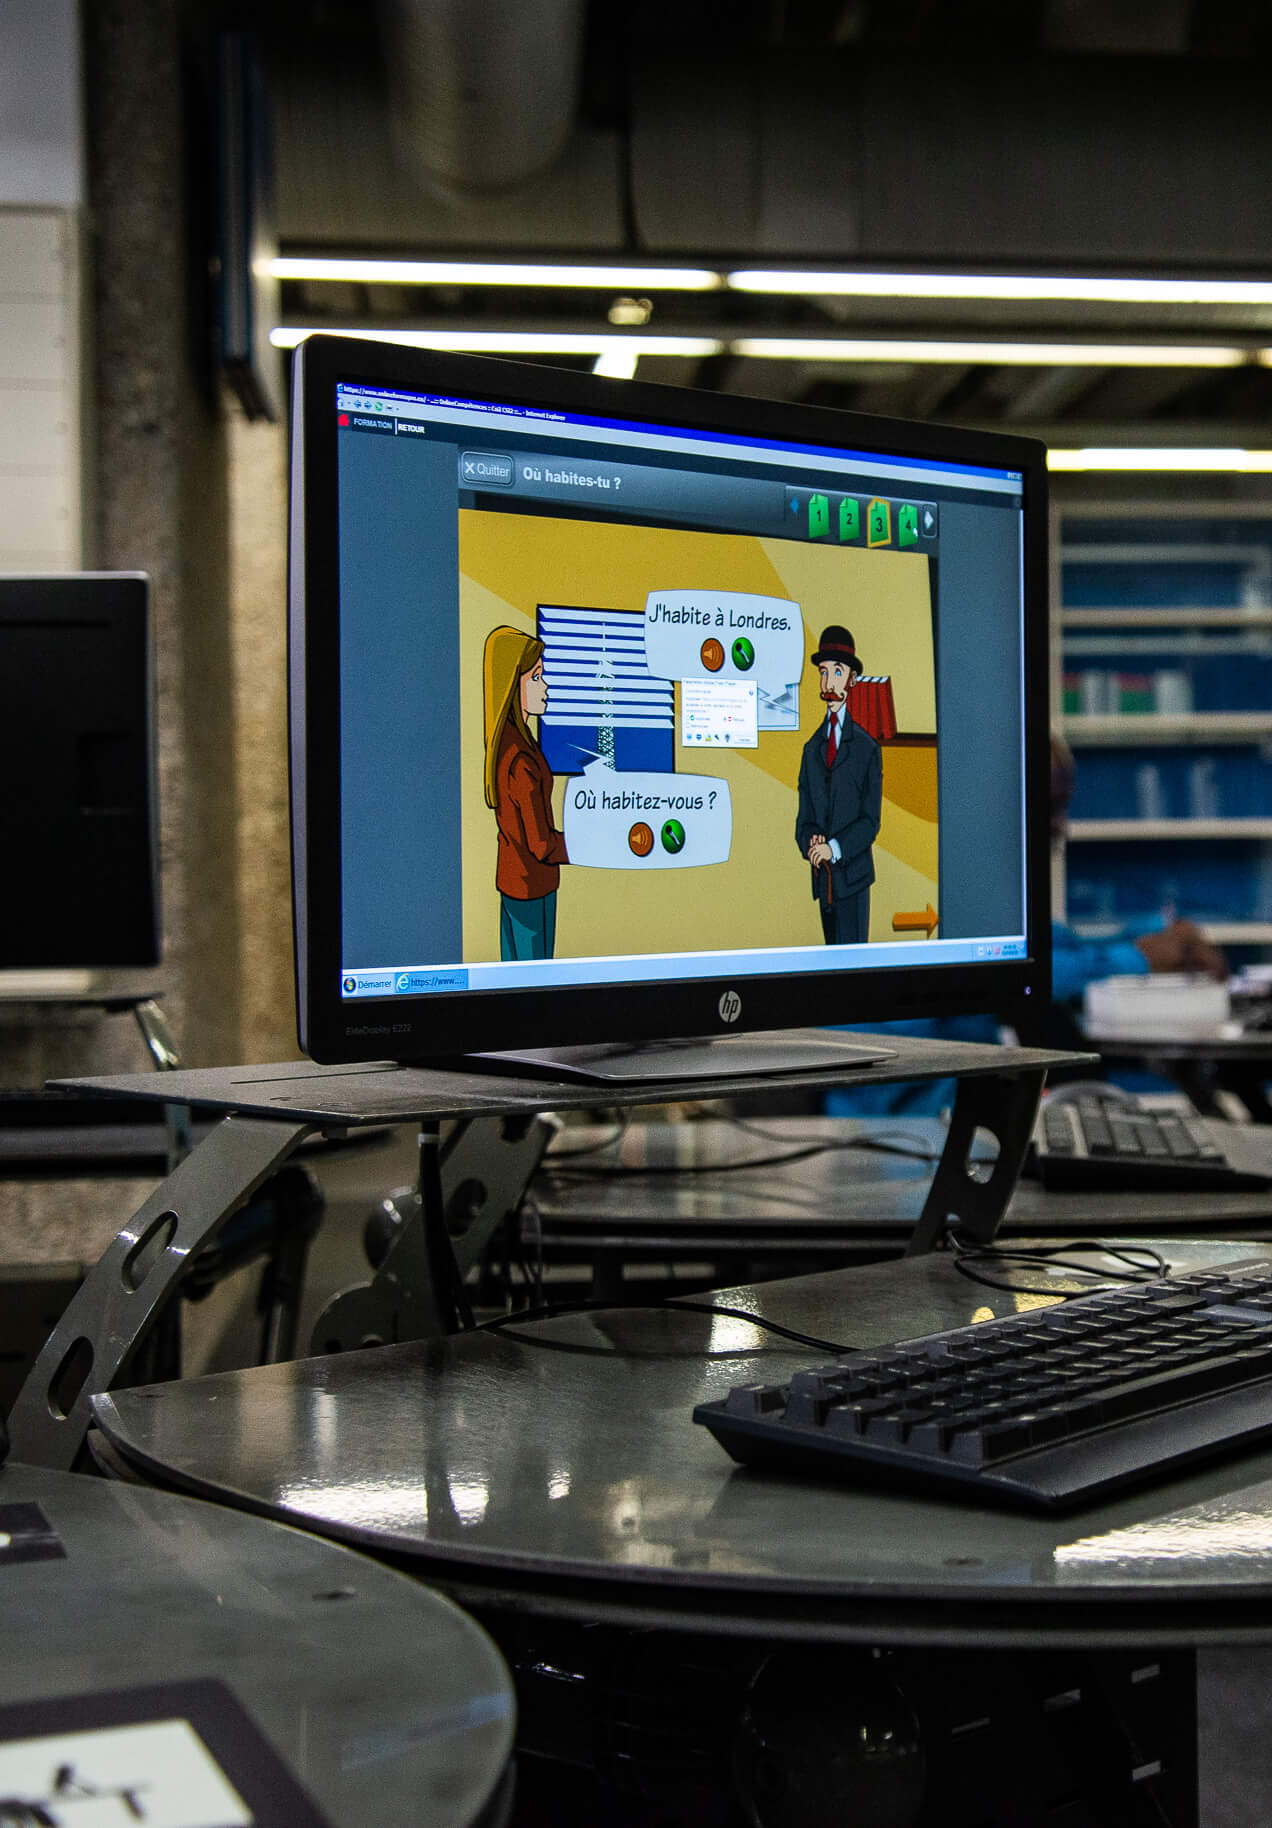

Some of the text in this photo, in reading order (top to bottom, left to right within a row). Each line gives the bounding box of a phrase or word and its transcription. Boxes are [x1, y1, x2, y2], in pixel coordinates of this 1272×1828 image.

[353, 417, 425, 434] FORMATION RETOUR
[476, 462, 511, 478] Quitter
[523, 466, 542, 481] Où
[545, 469, 611, 489] habites-tu
[846, 512, 853, 525] 2
[875, 516, 884, 533] 3
[905, 519, 912, 531] 4
[648, 602, 791, 631] J'habite à Londres.
[574, 789, 597, 810] Où
[601, 790, 704, 810] habitez-vous
[358, 980, 393, 989] Démarrer
[720, 990, 740, 1024] hp
